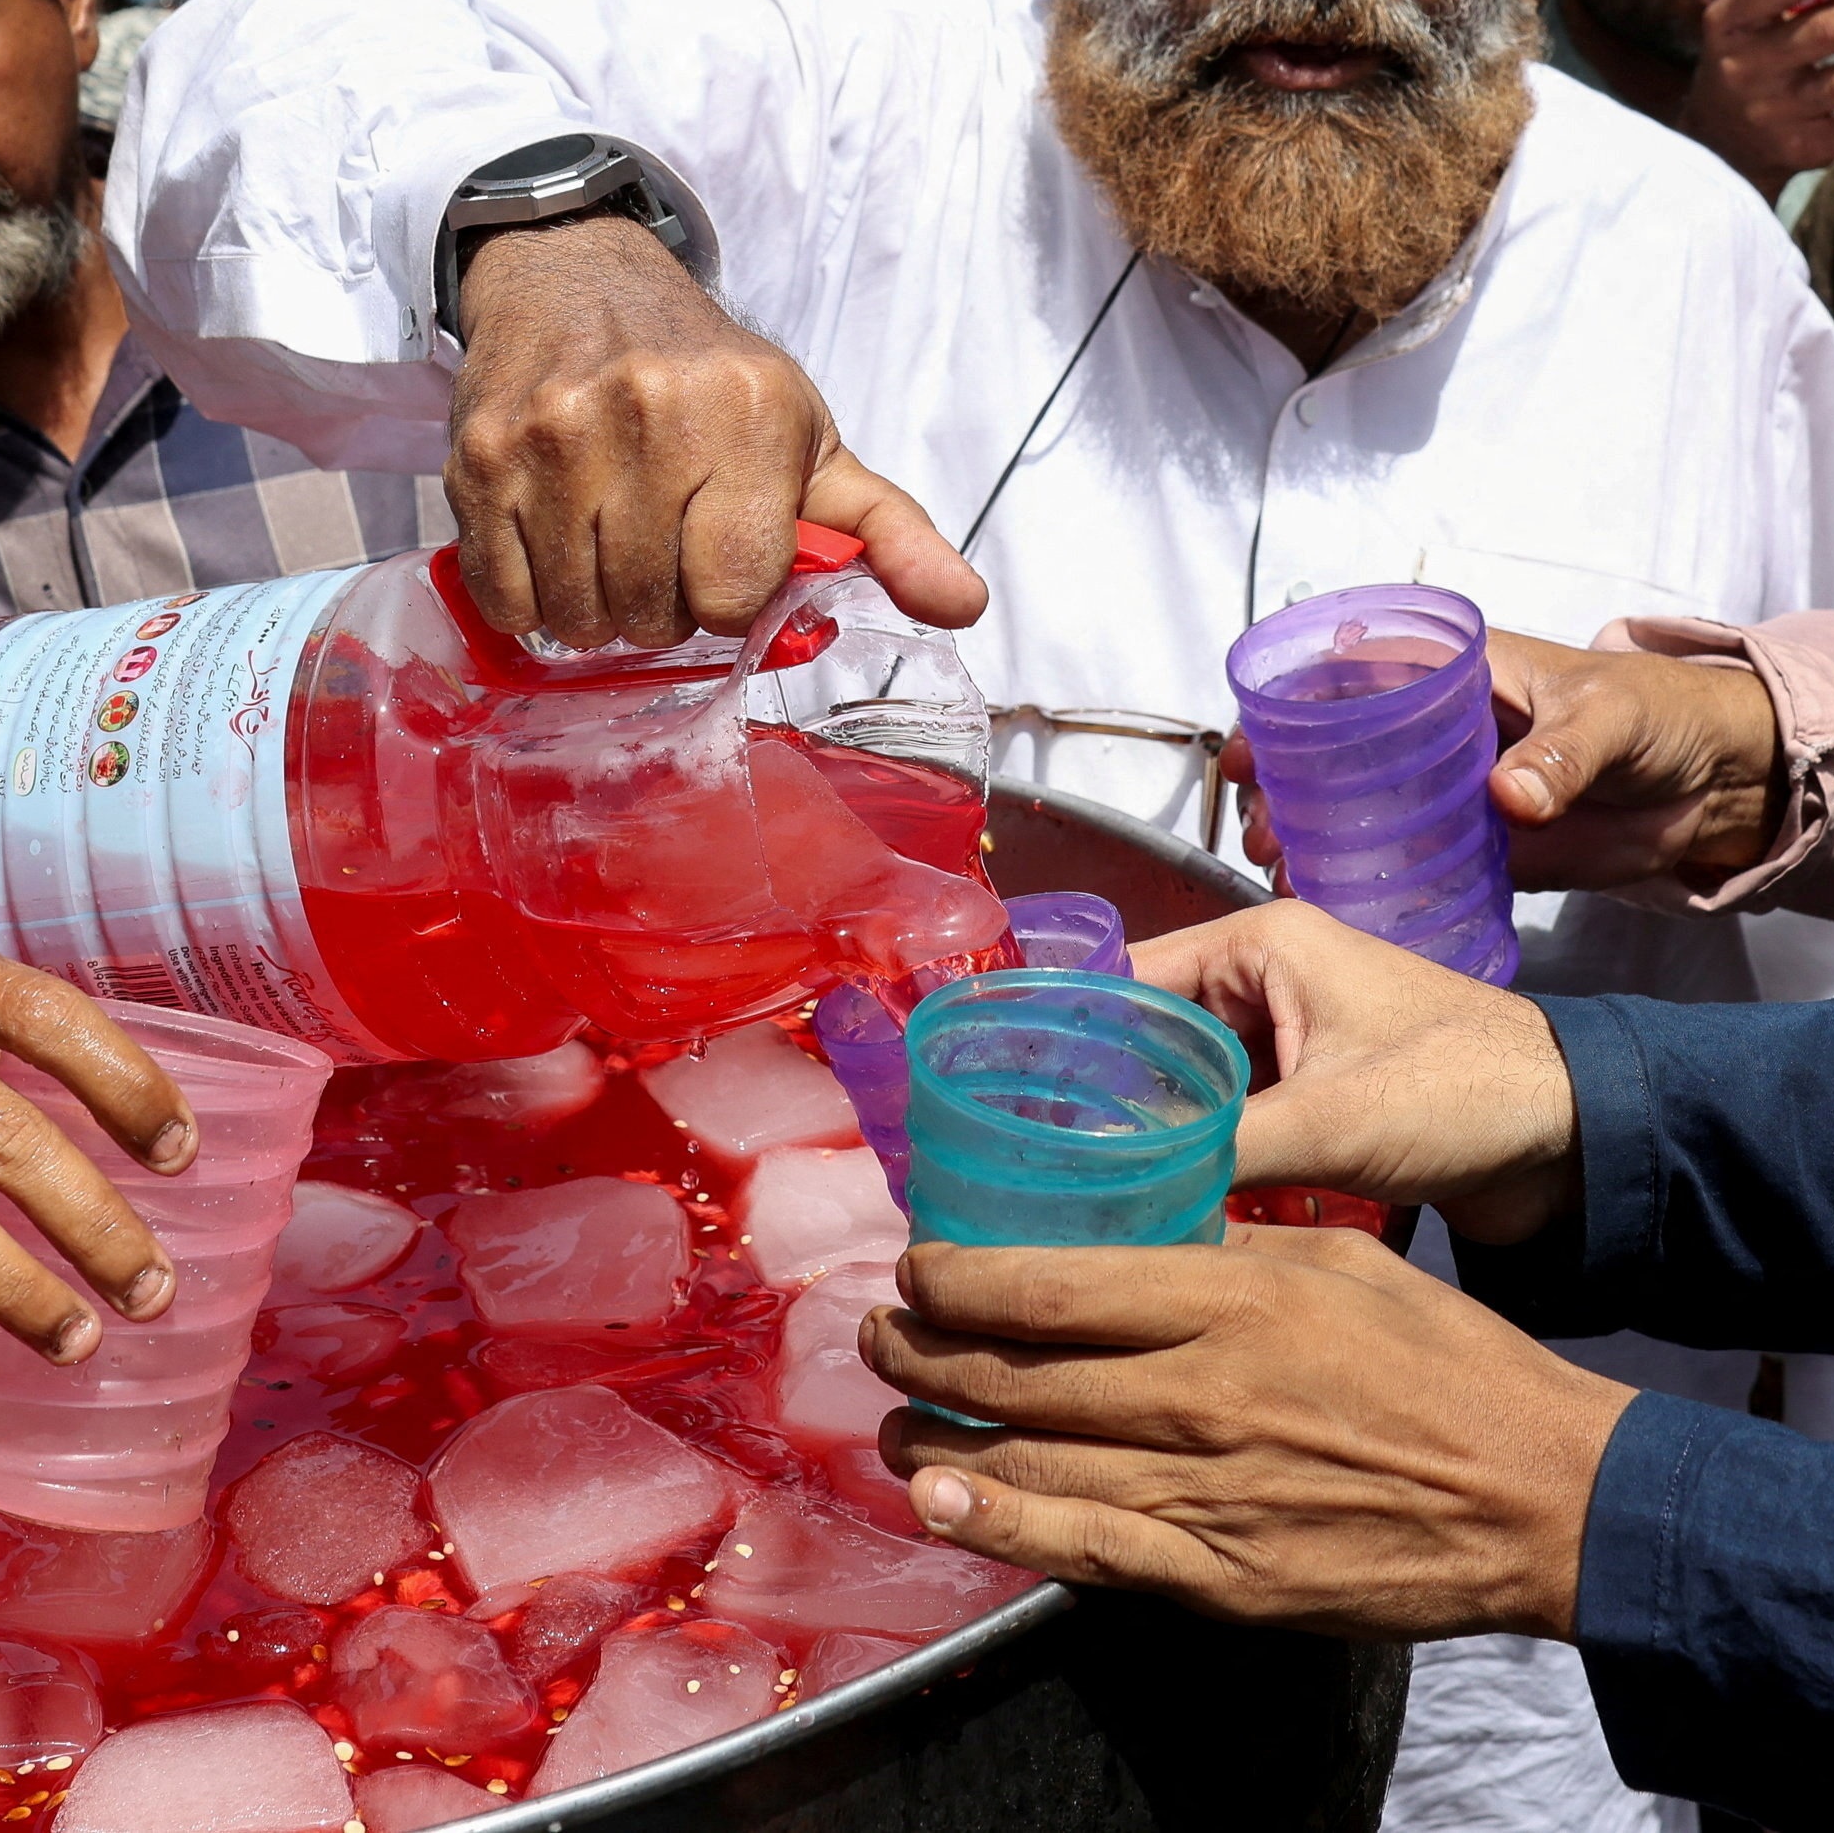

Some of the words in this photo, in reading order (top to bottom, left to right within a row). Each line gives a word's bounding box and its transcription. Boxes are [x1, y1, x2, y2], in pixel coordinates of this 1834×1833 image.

[242, 649, 278, 706] افزا
[228, 705, 270, 767] روح
[168, 948, 181, 967] Use
[176, 967, 193, 993] within
[180, 945, 190, 959] Do
[186, 959, 199, 975] not
[208, 945, 244, 1004] Ingredients:
[225, 943, 252, 987] Enhance
[246, 987, 260, 1002] the
[250, 961, 268, 982] For
[262, 984, 280, 1000] all
[271, 999, 305, 1035] seasons
